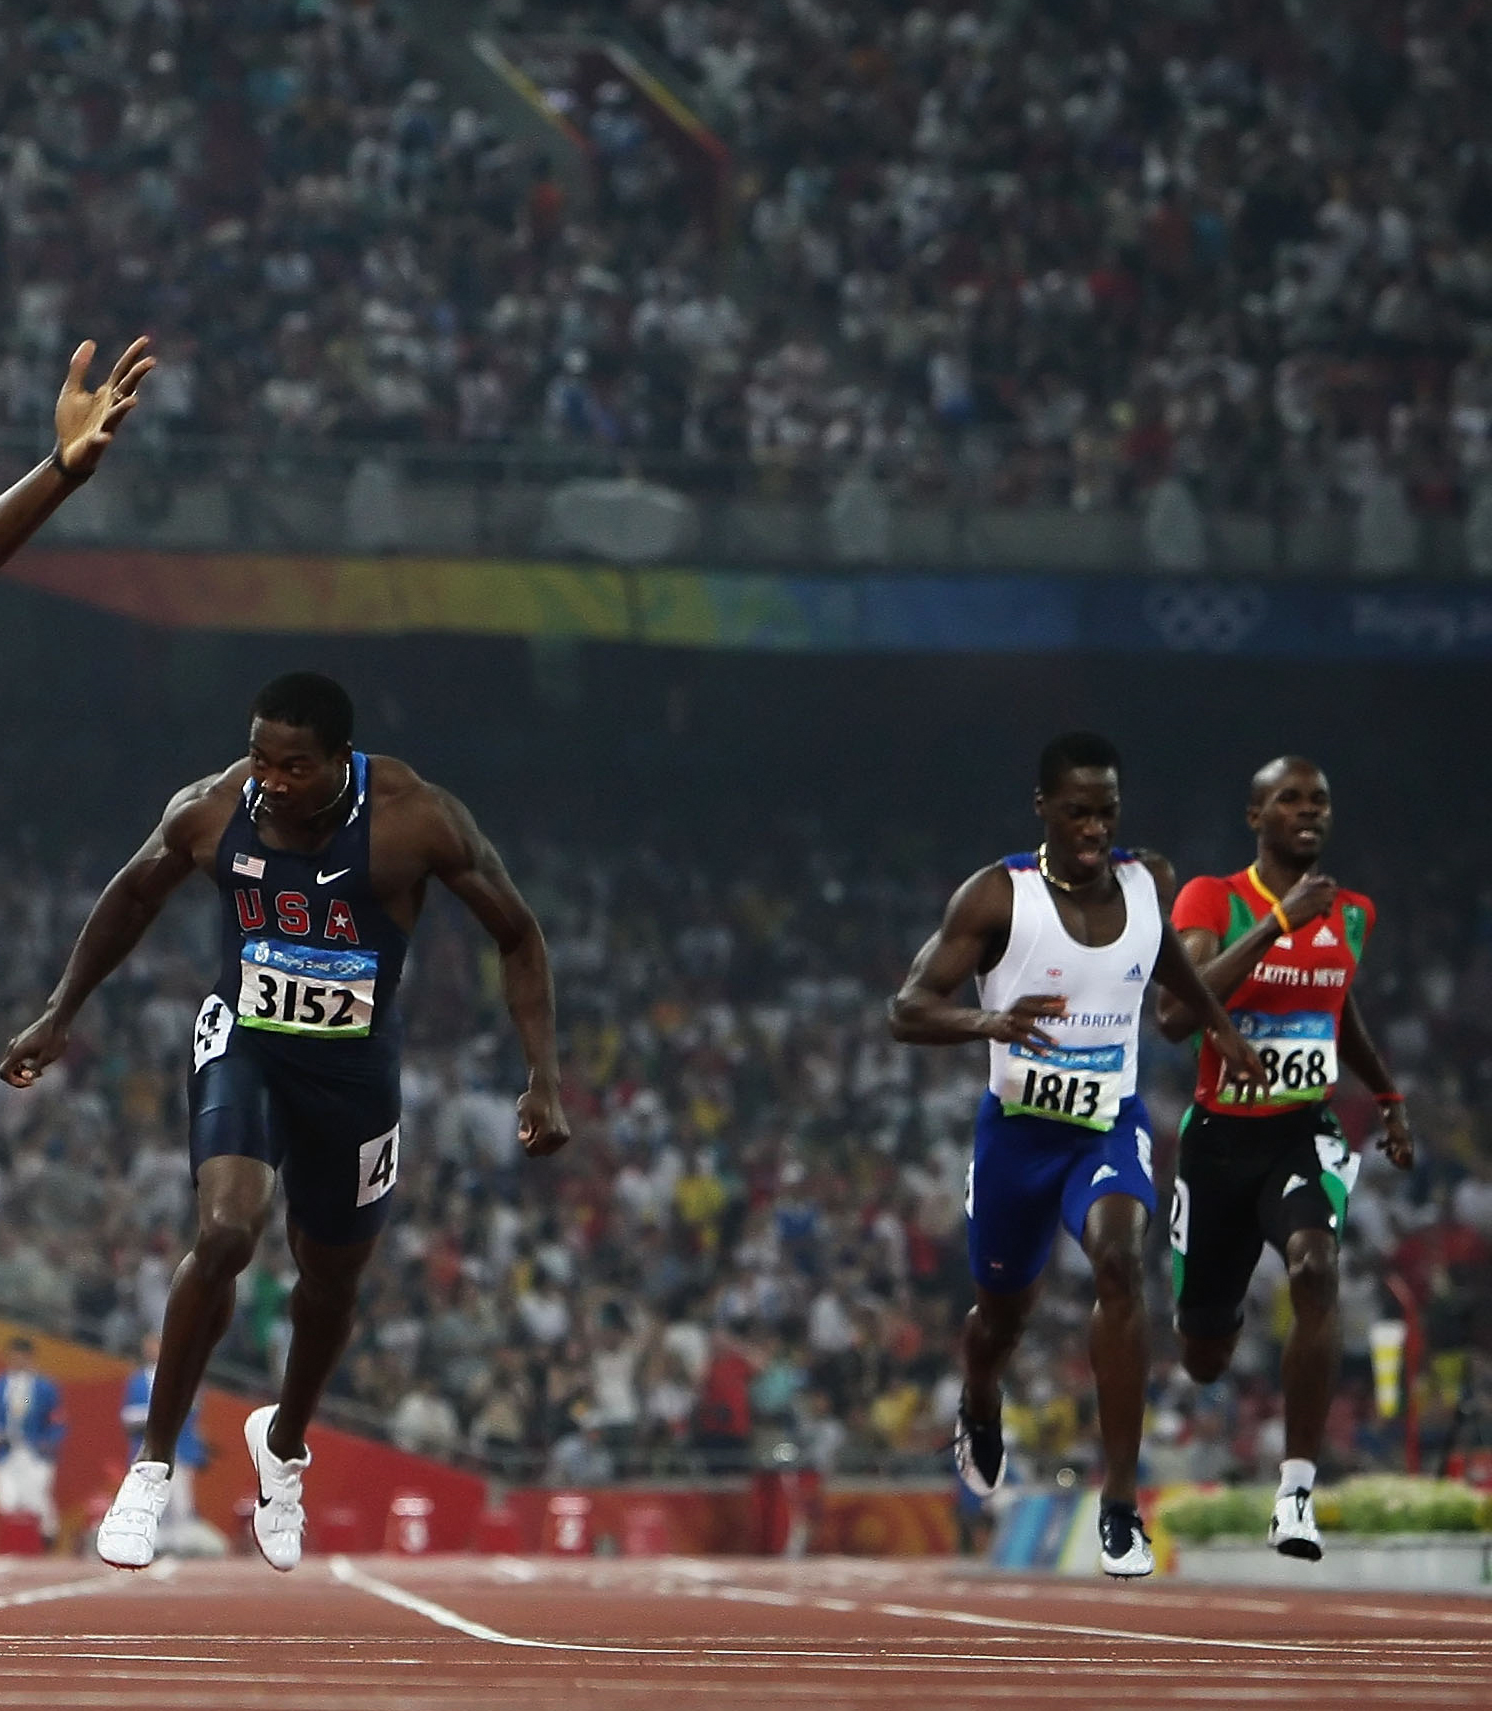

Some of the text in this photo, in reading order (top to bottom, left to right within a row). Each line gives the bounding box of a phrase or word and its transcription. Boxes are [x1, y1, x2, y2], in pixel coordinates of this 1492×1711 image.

[234, 887, 359, 945] USA
[1253, 961, 1300, 987] T.KITTS
[256, 973, 354, 1027] 3152
[1037, 1011, 1077, 1028] REAT
[1021, 1068, 1101, 1118] 1813
[1259, 1048, 1328, 1090] 868
[368, 1136, 395, 1188] 4
